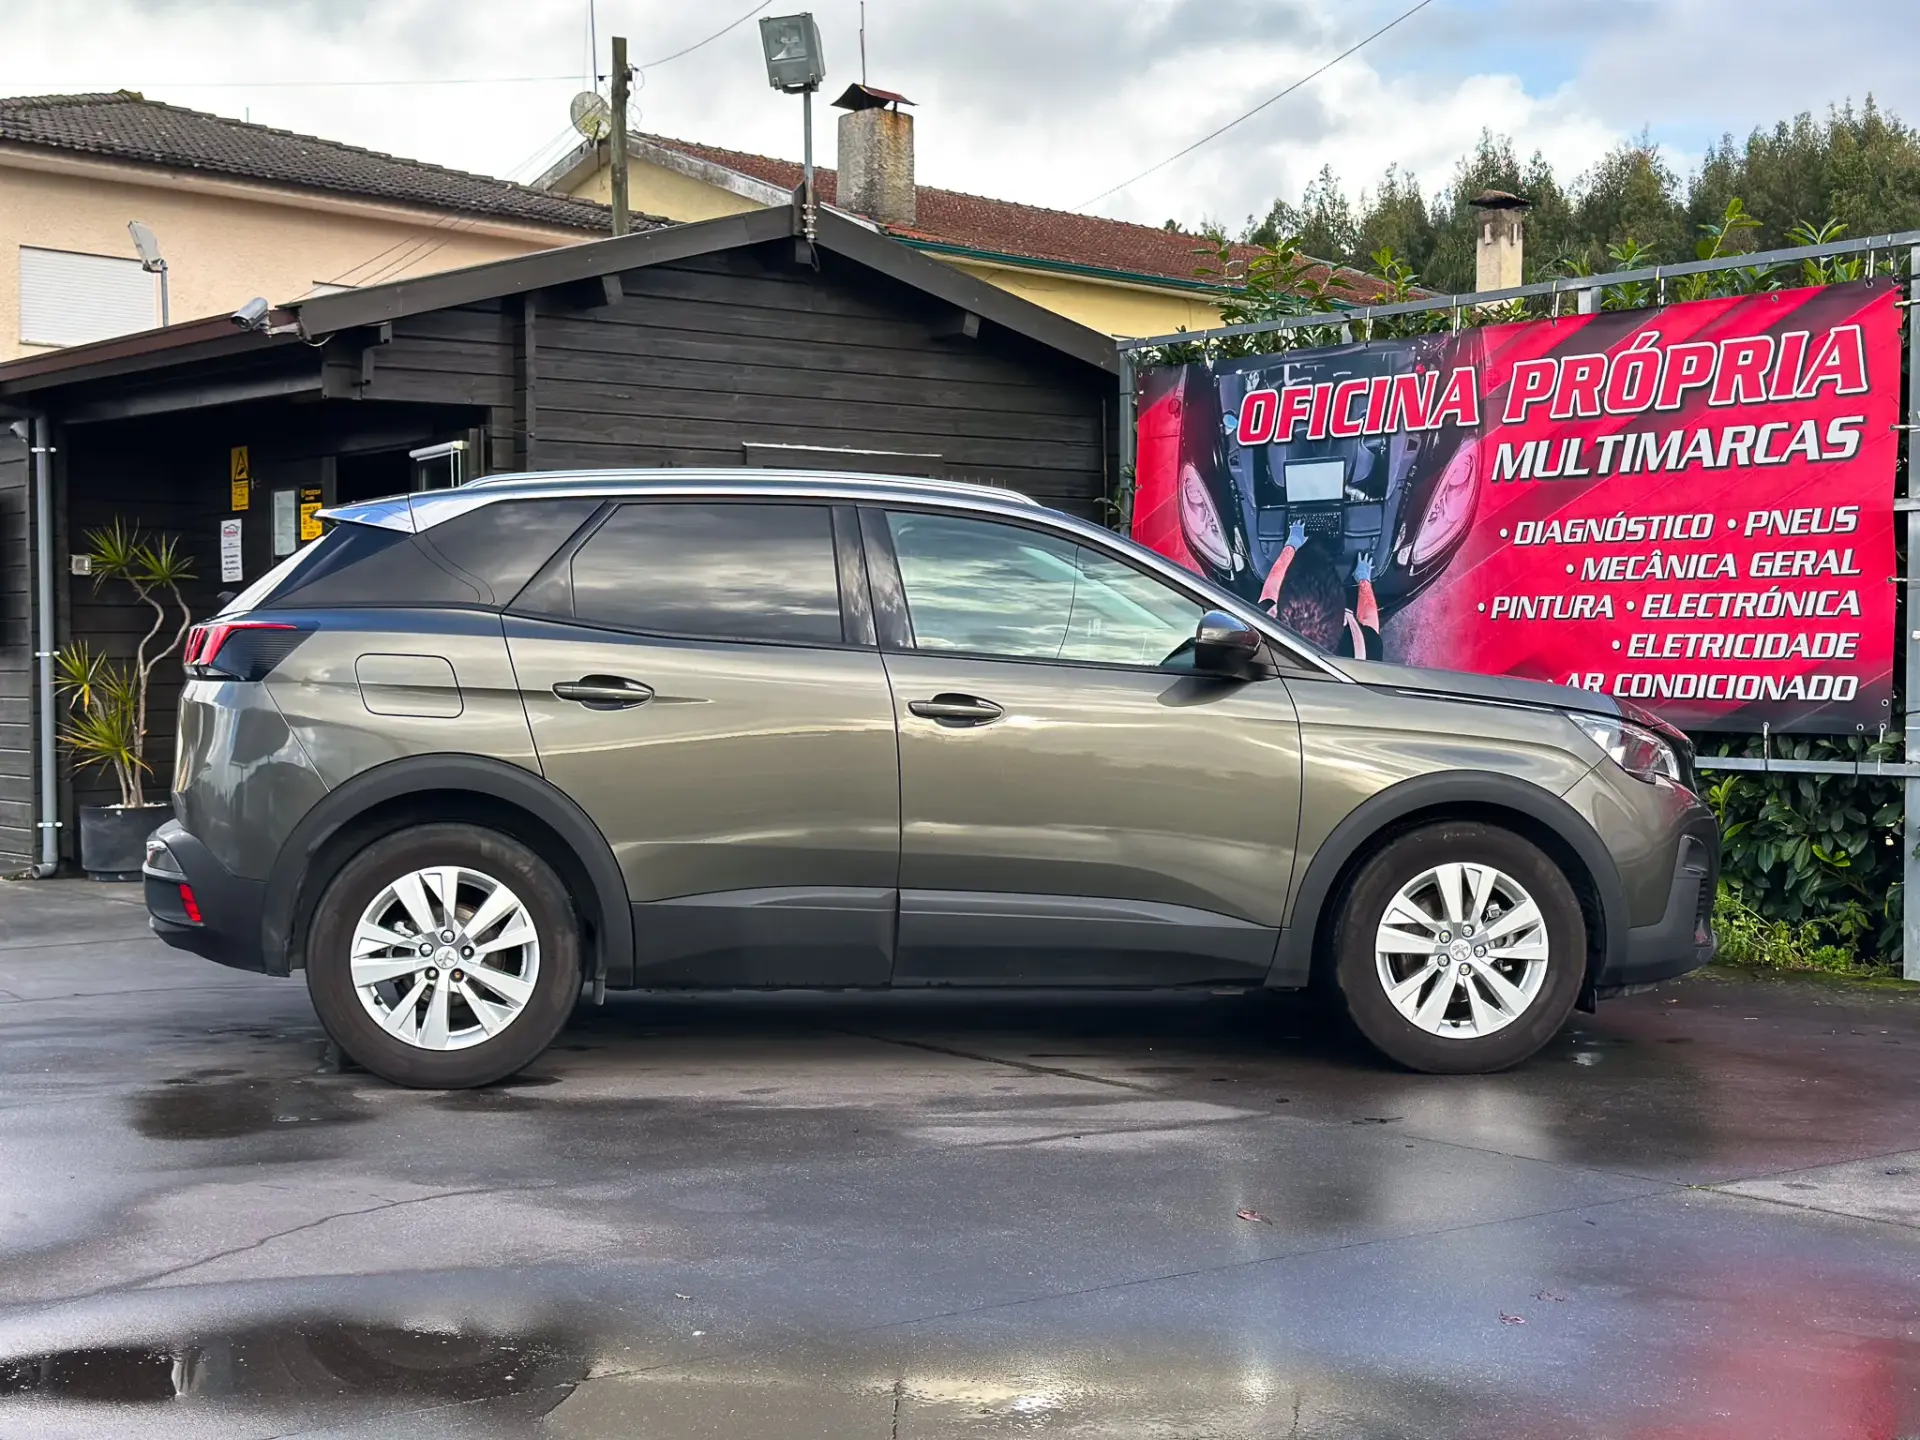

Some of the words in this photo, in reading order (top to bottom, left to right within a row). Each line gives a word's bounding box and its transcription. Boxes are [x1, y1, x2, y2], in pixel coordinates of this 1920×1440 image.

[1237, 366, 1480, 446] OFICINA
[1502, 324, 1869, 423] PRÓPRIA
[1491, 416, 1864, 481] MULTIMARCAS
[1513, 512, 1714, 545] DIAGNÓSTICO
[1743, 506, 1858, 537] PNEUS
[1580, 550, 1737, 581] MECÂNICA
[1749, 548, 1861, 577] GERAL
[1490, 595, 1613, 619] PINTURA
[1640, 586, 1860, 618] ELECTRÓNICA
[1627, 632, 1859, 658] ELETRICIDADE
[1613, 673, 1859, 701] CONDICIONADO
